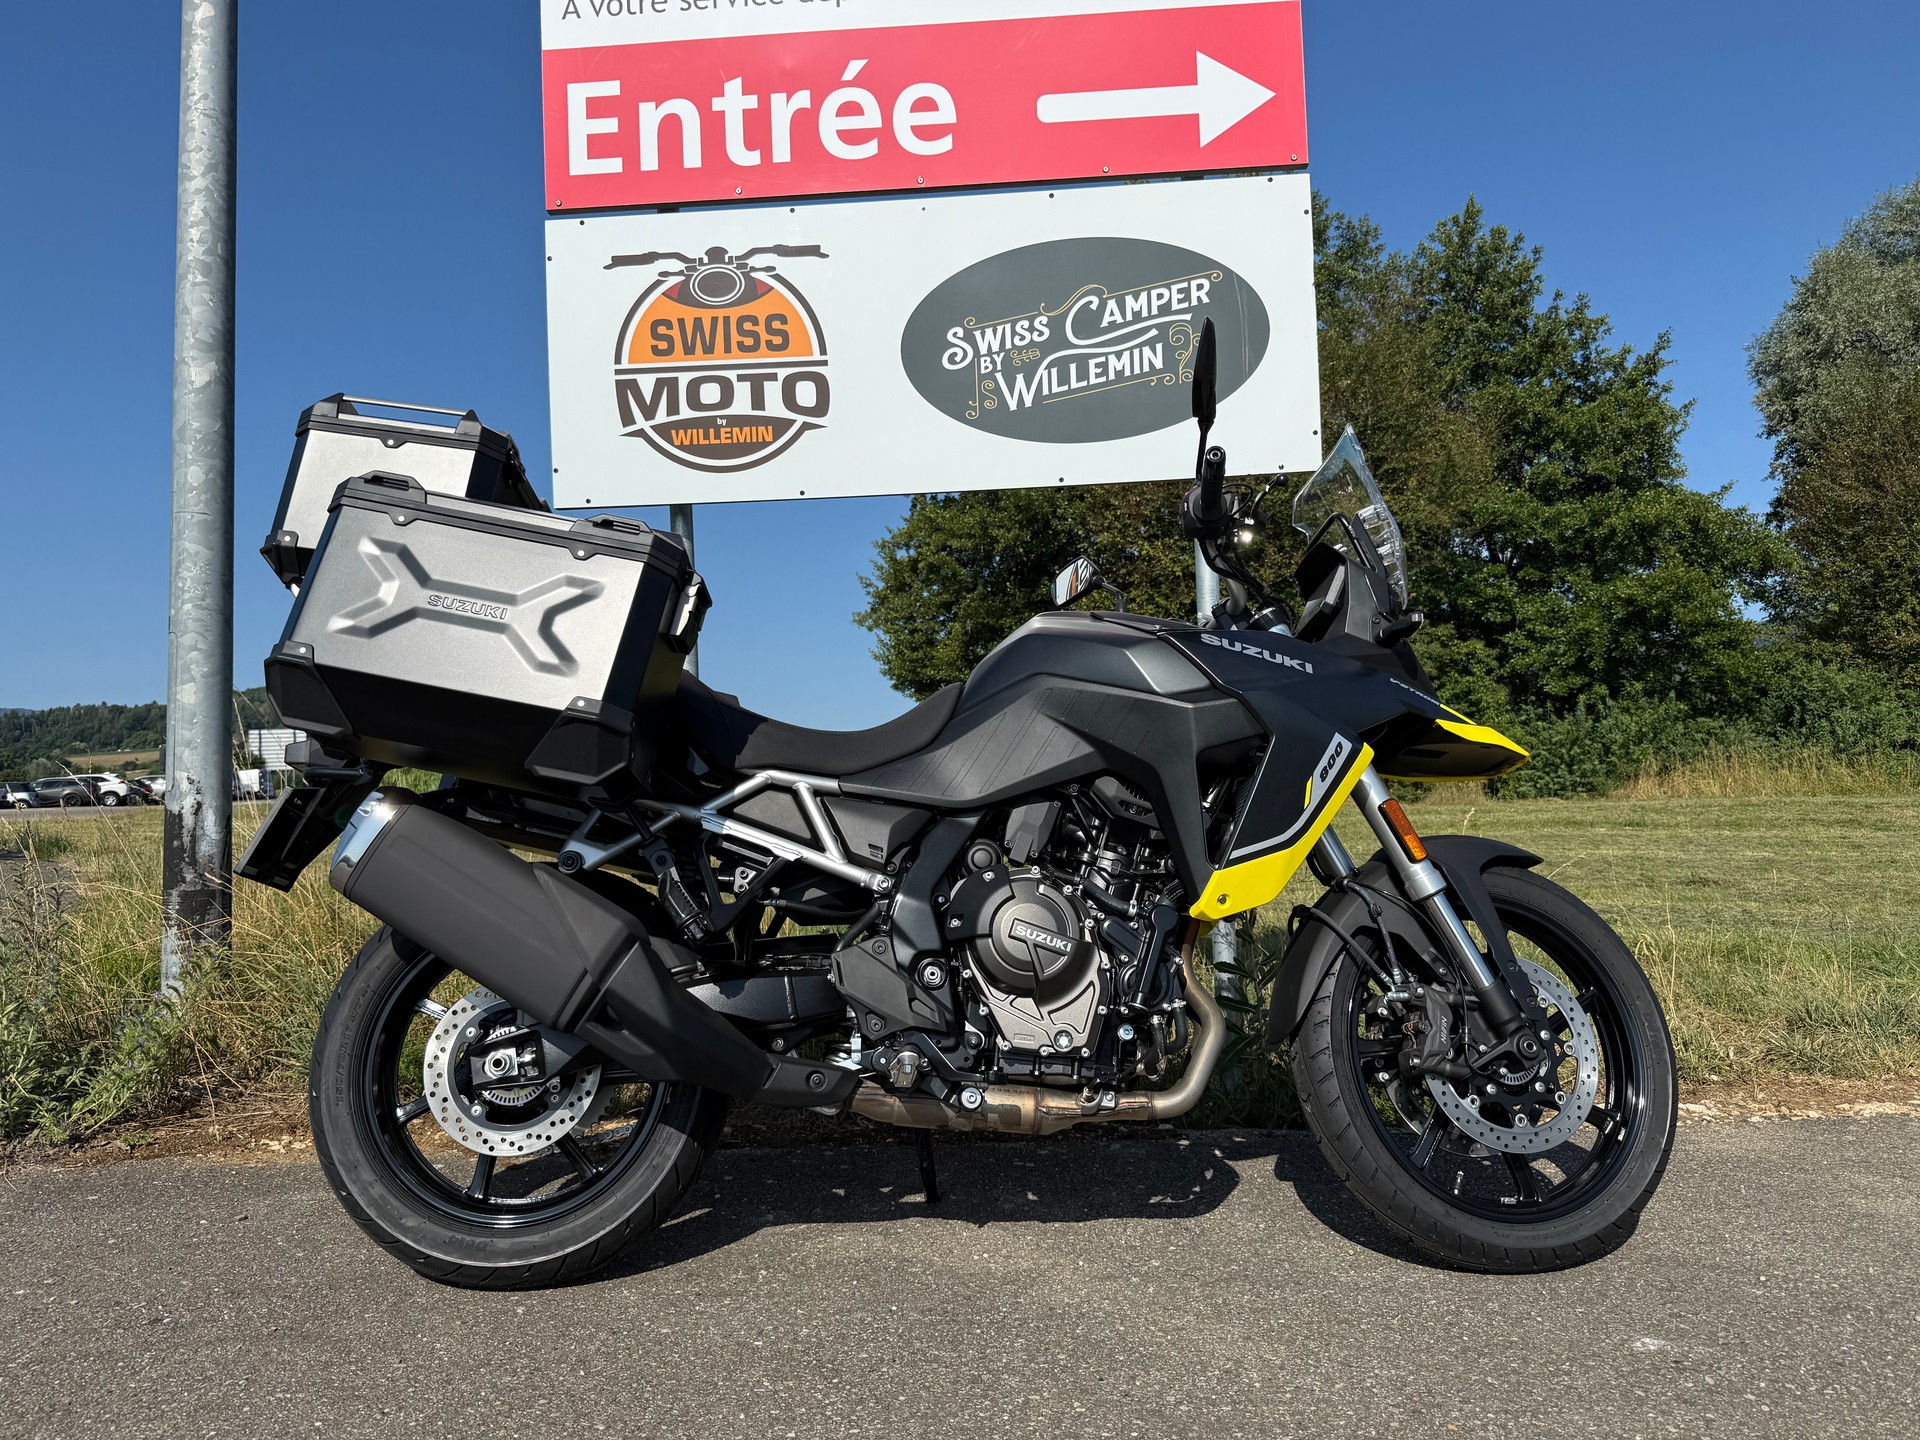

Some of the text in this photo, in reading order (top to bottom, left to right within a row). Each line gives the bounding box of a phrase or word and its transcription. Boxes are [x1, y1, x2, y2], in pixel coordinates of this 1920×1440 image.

[589, 0, 668, 18] votre
[566, 58, 958, 176] Entrée
[650, 313, 790, 357] SWISS
[941, 277, 1211, 370] SWISS CAMPER
[979, 352, 1006, 375] BY
[995, 336, 1165, 412] WILLEMIN
[615, 371, 831, 428] MOTO
[670, 426, 774, 446] WILLEMIN
[716, 417, 727, 427] by
[427, 594, 509, 620] SUZUKI
[1200, 633, 1314, 675] SUZUKI
[1319, 741, 1344, 783] 800
[1015, 925, 1072, 952] SUZUKI
